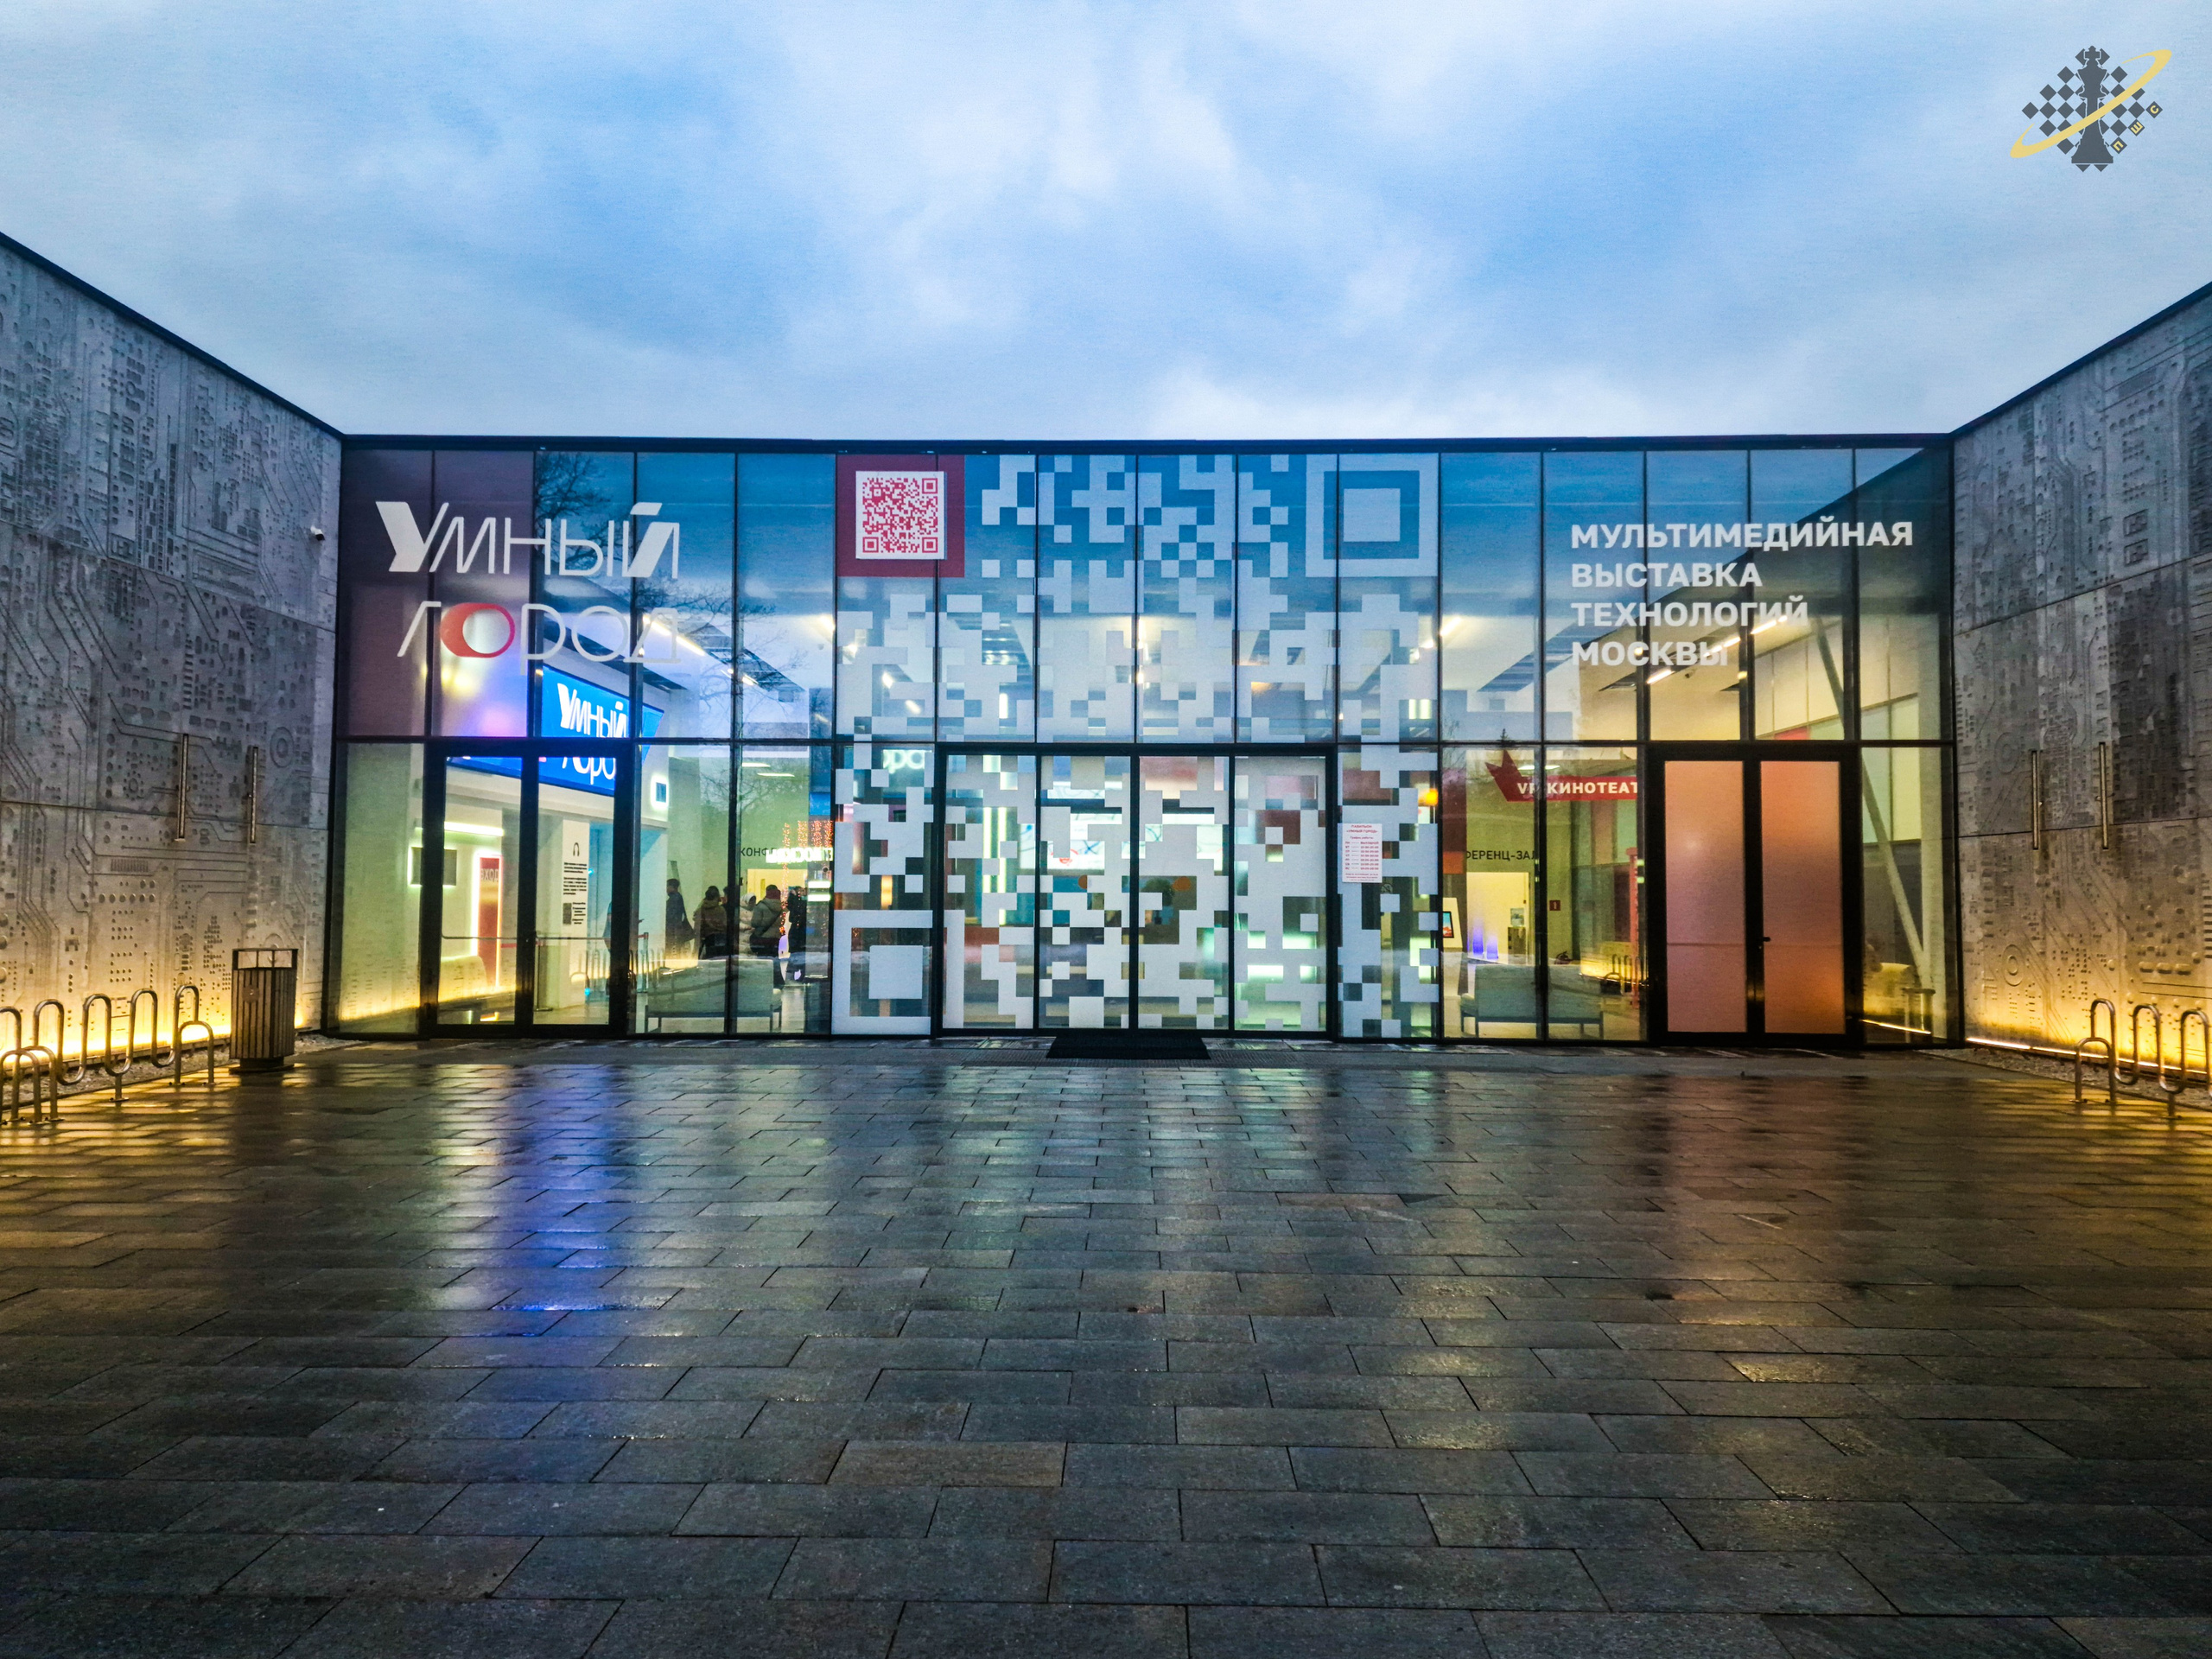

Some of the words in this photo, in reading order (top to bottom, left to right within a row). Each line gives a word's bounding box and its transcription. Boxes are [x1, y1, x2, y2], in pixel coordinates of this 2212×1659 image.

[1571, 515, 1913, 552] МУЛЬТИМЕДИЙНАЯ
[1571, 562, 1764, 588] ВЫСТАВКА
[1571, 594, 1808, 628] ТЕХНОЛОГИЙ
[1572, 640, 1728, 667] МОСКВЫ
[1547, 781, 1638, 794] КИНОТЕАТ
